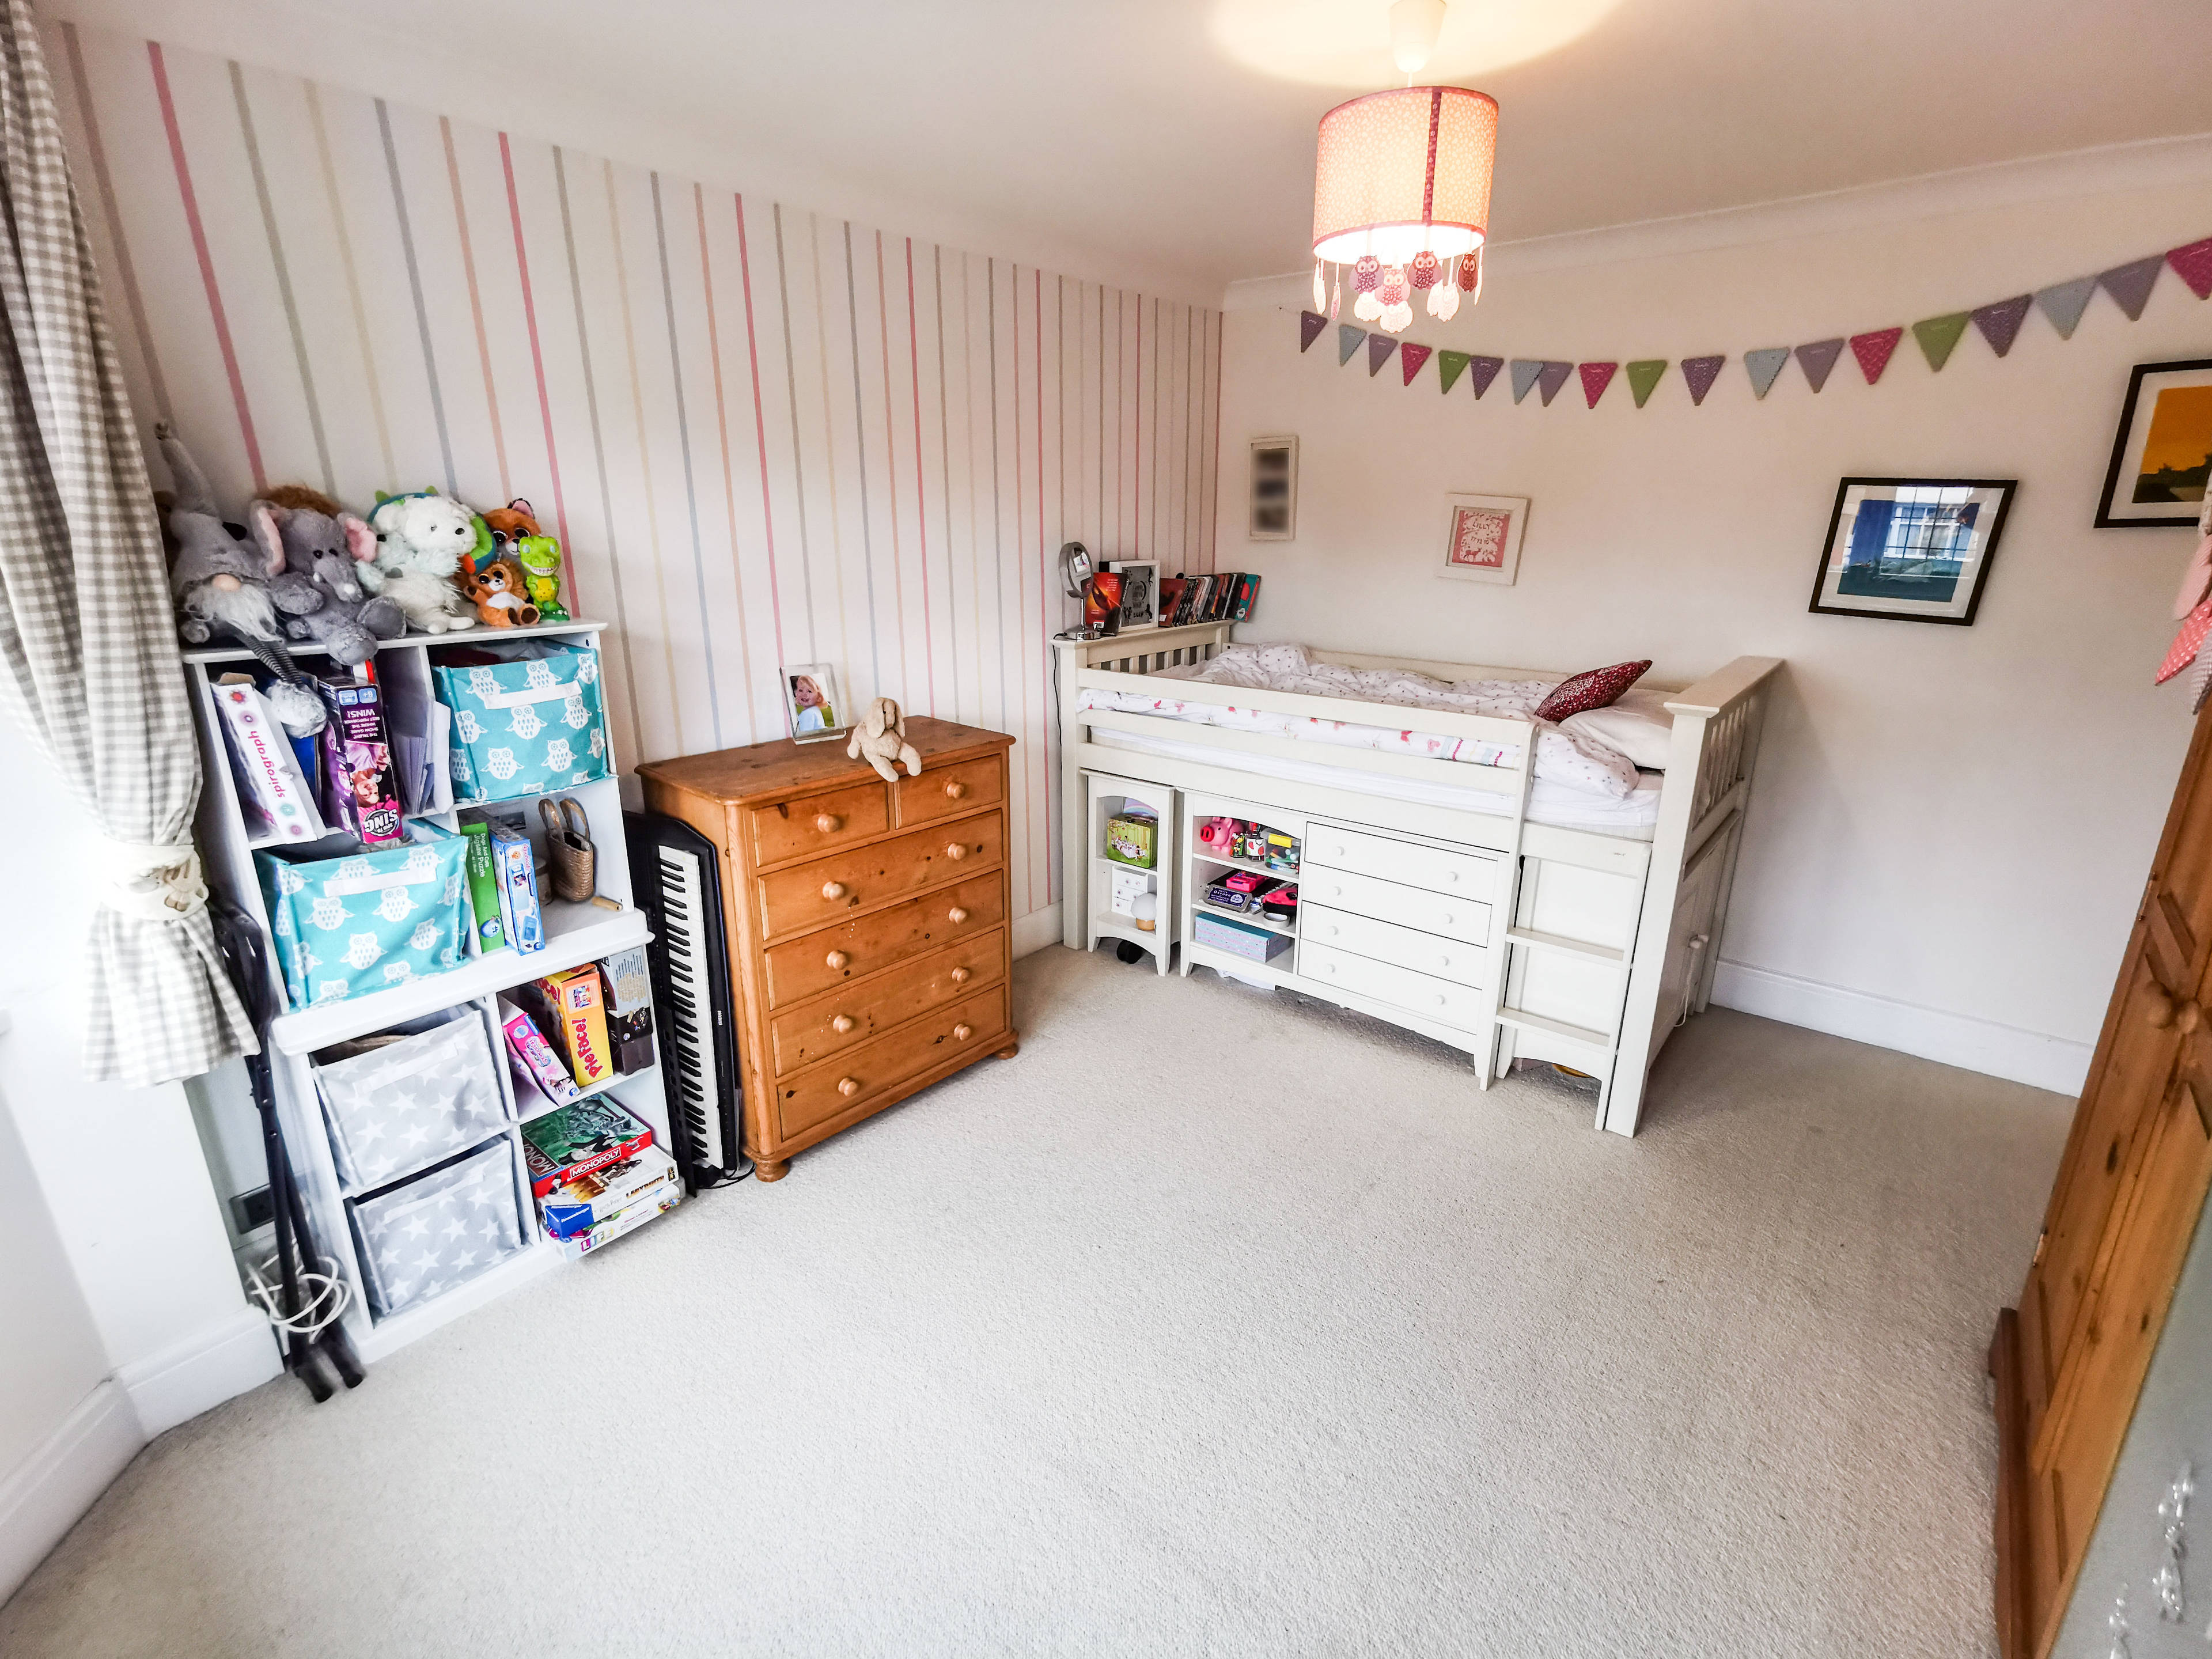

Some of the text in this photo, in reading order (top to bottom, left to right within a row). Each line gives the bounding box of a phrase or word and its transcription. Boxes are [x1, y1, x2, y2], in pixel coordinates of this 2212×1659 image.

[1472, 521, 1490, 529] LILLY
[347, 709, 376, 718] WINS!
[248, 730, 286, 798] spirograph
[363, 809, 397, 832] SING
[474, 834, 486, 877] Jigsaw Puzzle
[571, 1149, 620, 1176] MONOPOLY
[581, 1227, 615, 1252] LIFE
